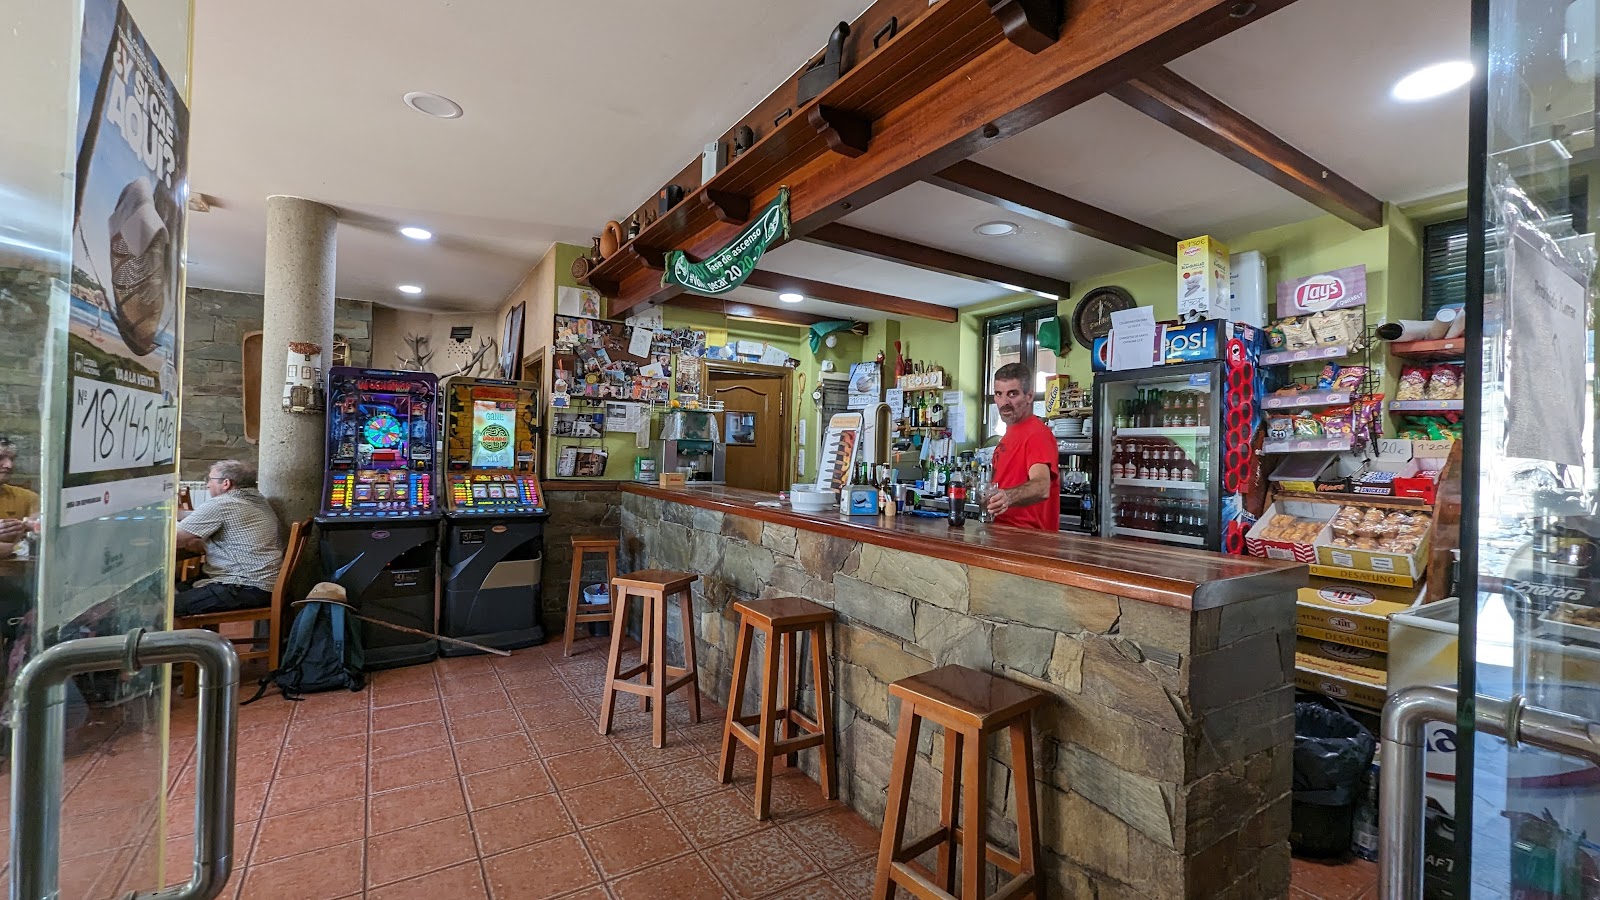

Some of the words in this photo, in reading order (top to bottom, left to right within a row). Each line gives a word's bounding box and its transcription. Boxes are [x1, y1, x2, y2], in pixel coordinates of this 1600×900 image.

[150, 94, 174, 147] CAE
[706, 258, 724, 273] Fase
[722, 254, 733, 266] de
[731, 227, 761, 256] ascenso
[1165, 327, 1207, 354] psi
[1360, 486, 1390, 495] SNICKERS
[1340, 570, 1396, 584] DESAYUNO
[1324, 632, 1380, 649] DESAYUNO
